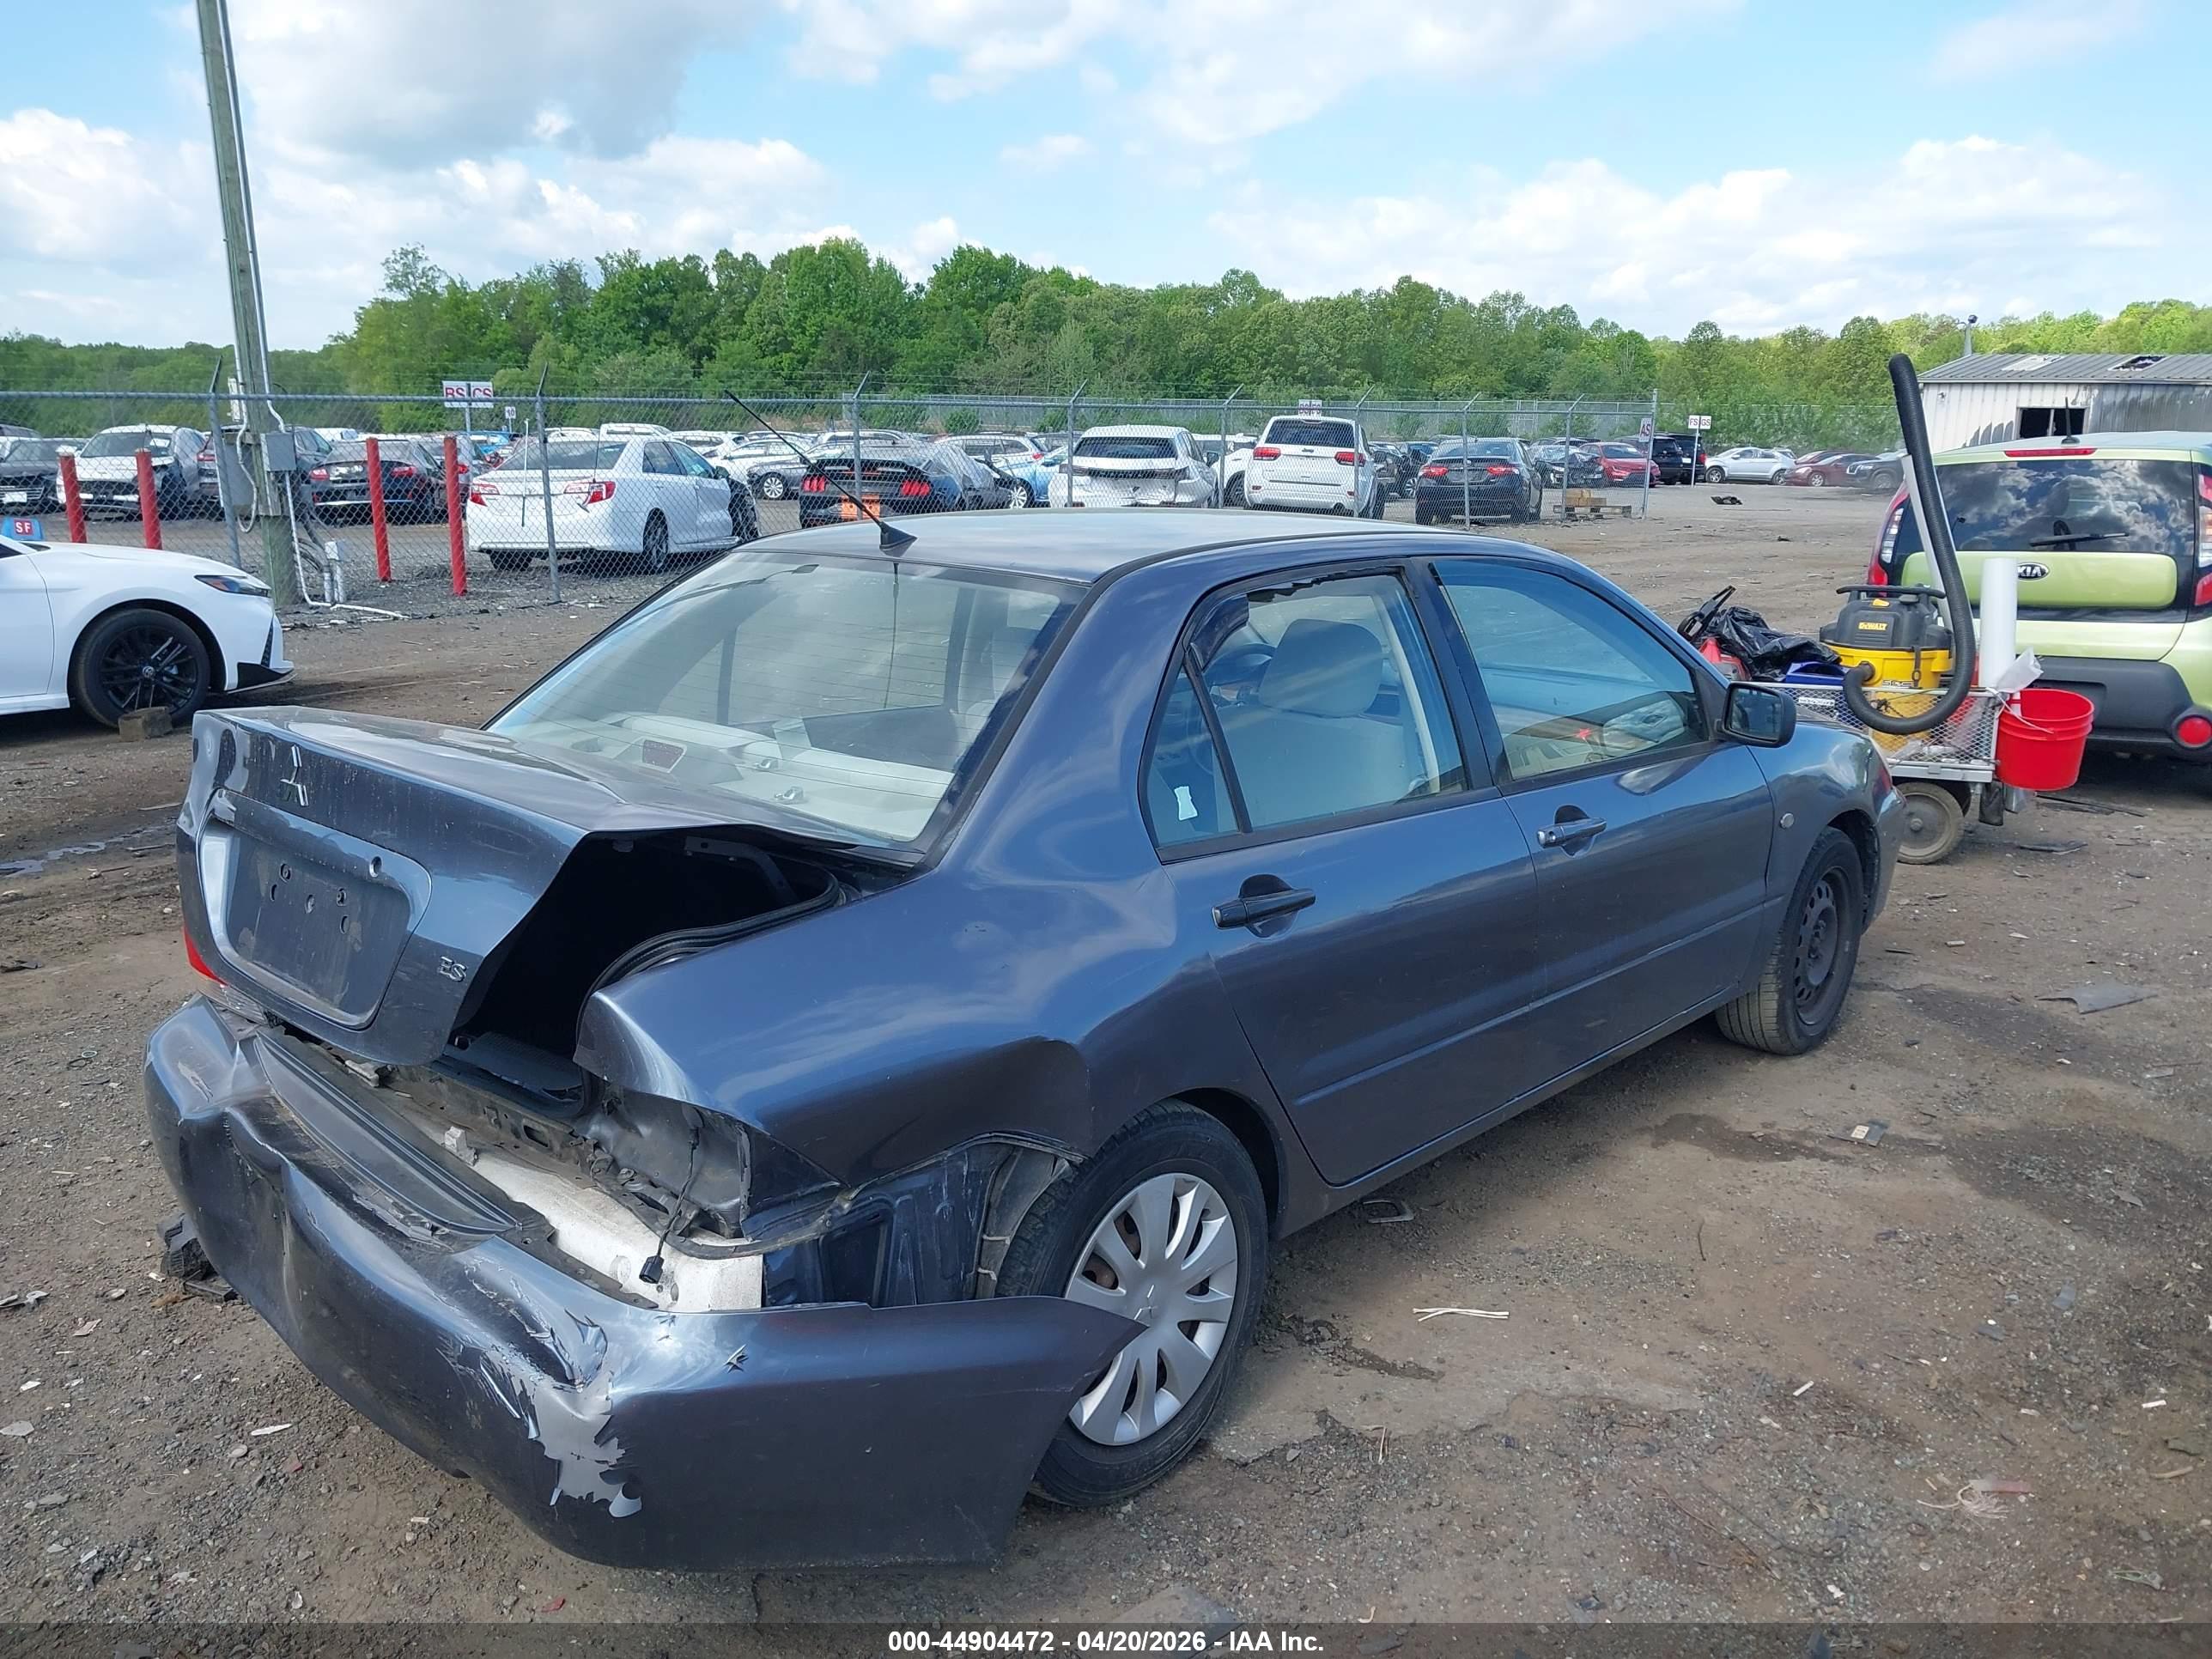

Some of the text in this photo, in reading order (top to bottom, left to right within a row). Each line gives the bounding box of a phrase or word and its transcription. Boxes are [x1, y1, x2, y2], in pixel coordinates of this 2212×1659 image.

[1640, 423, 1650, 436] AS
[2018, 566, 2042, 576] KIA
[440, 956, 466, 981] ES
